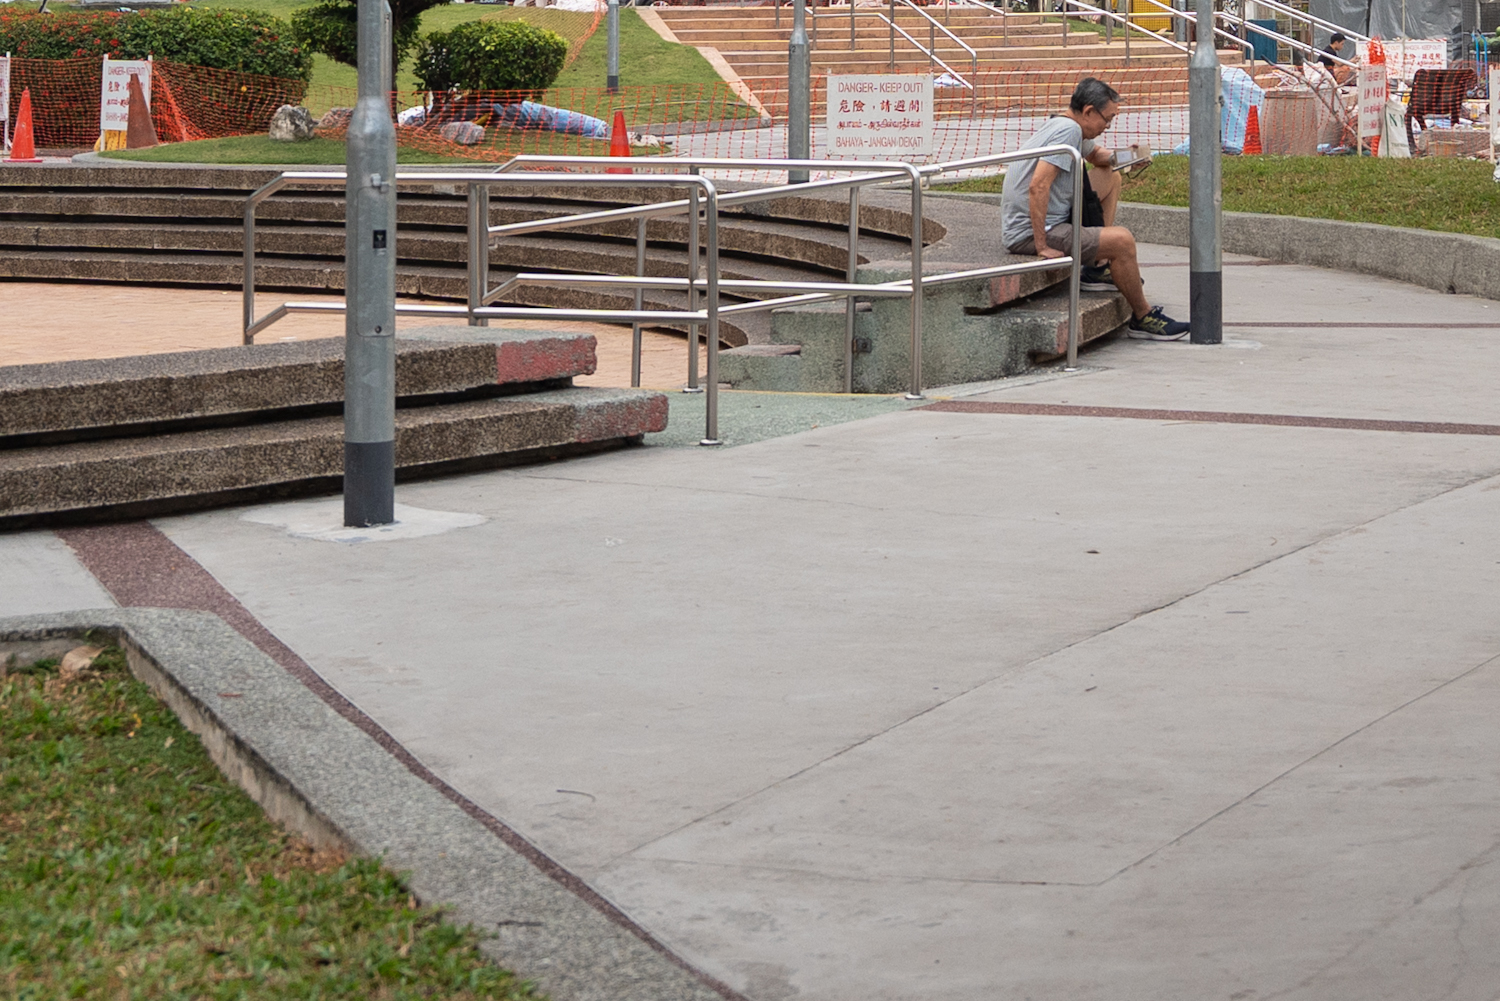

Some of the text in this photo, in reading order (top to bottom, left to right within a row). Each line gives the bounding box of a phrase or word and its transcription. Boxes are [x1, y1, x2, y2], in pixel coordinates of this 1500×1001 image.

[879, 82, 902, 93] KEEP
[903, 82, 924, 93] OUT!
[898, 136, 924, 148] DEKAT!
